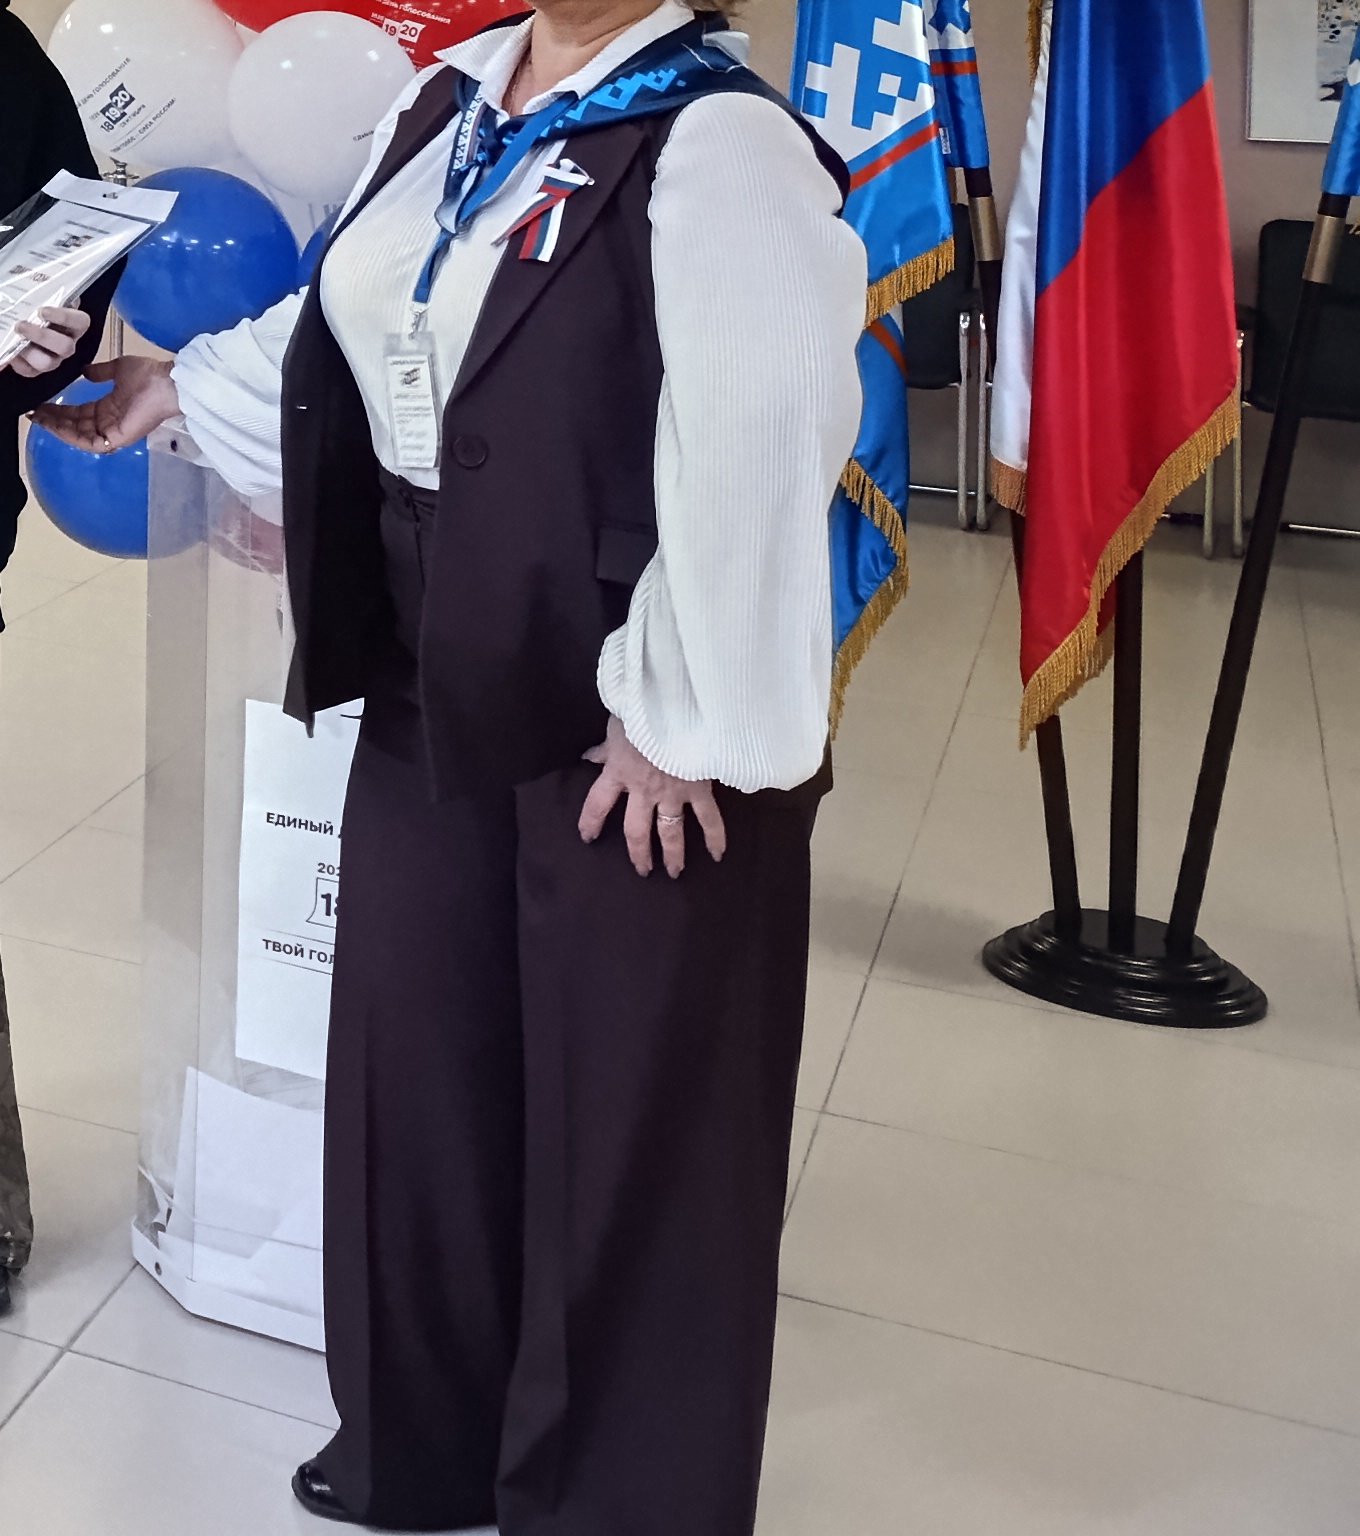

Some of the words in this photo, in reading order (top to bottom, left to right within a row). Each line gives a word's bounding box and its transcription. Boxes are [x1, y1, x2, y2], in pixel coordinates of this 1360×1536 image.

[384, 24, 397, 36] 19
[400, 24, 418, 38] 20
[112, 90, 130, 107] 20
[105, 107, 120, 121] 19
[100, 121, 115, 133] 18
[266, 812, 334, 835] ЕДИНЫЙ
[262, 938, 304, 958] ТВОЙ
[309, 948, 336, 965] ГОЛ
